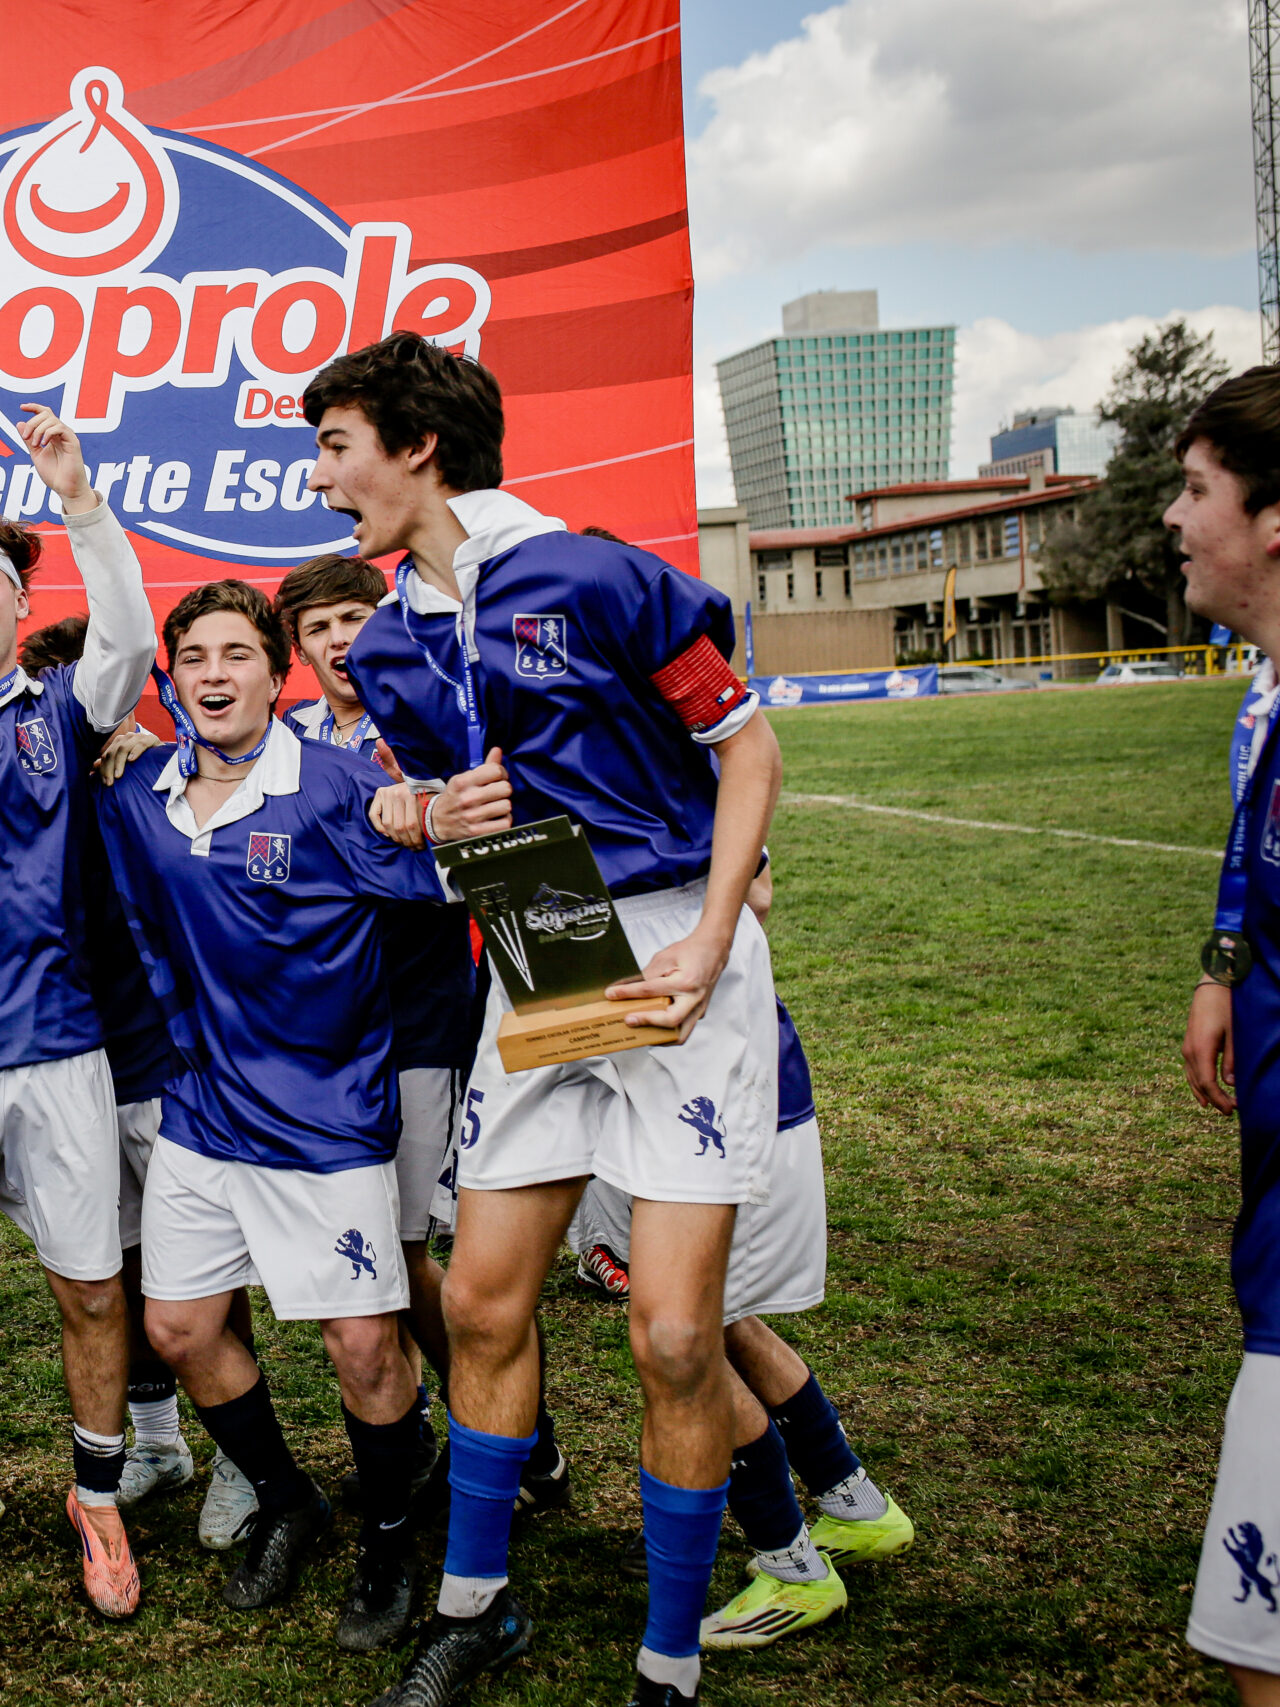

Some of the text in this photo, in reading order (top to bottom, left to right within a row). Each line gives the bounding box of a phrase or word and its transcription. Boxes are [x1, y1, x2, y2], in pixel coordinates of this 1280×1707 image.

[165, 684, 173, 703] COPA
[172, 703, 192, 731] SOPROLE
[460, 1087, 485, 1150] 5
